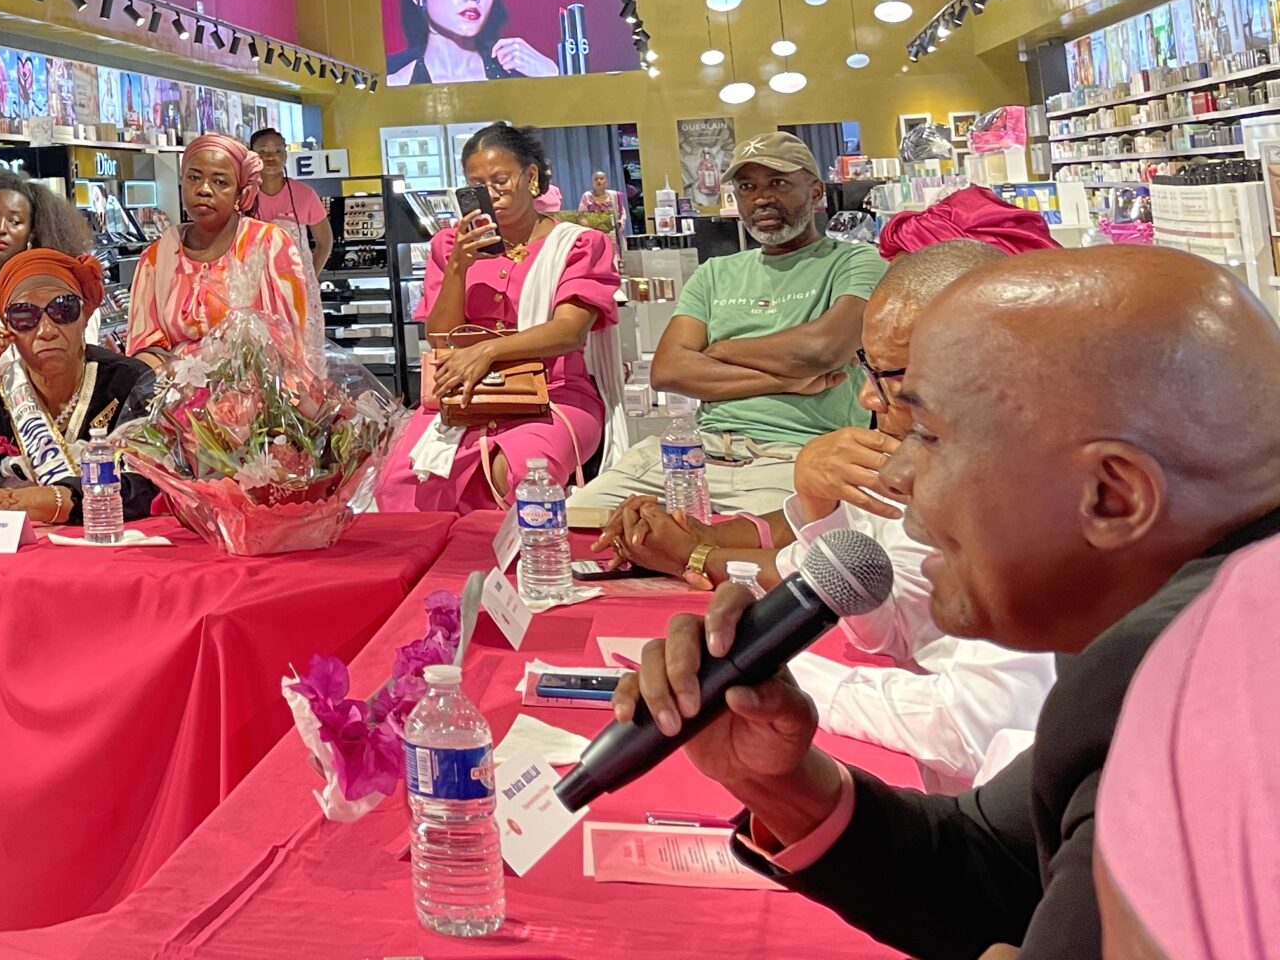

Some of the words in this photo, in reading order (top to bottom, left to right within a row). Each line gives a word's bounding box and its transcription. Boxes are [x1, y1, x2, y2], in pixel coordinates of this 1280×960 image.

[681, 122, 728, 132] GUERLAIN
[95, 152, 117, 176] Dior
[713, 297, 756, 307] TOMMY
[771, 288, 817, 307] HILFIGER
[20, 417, 60, 469] MISS
